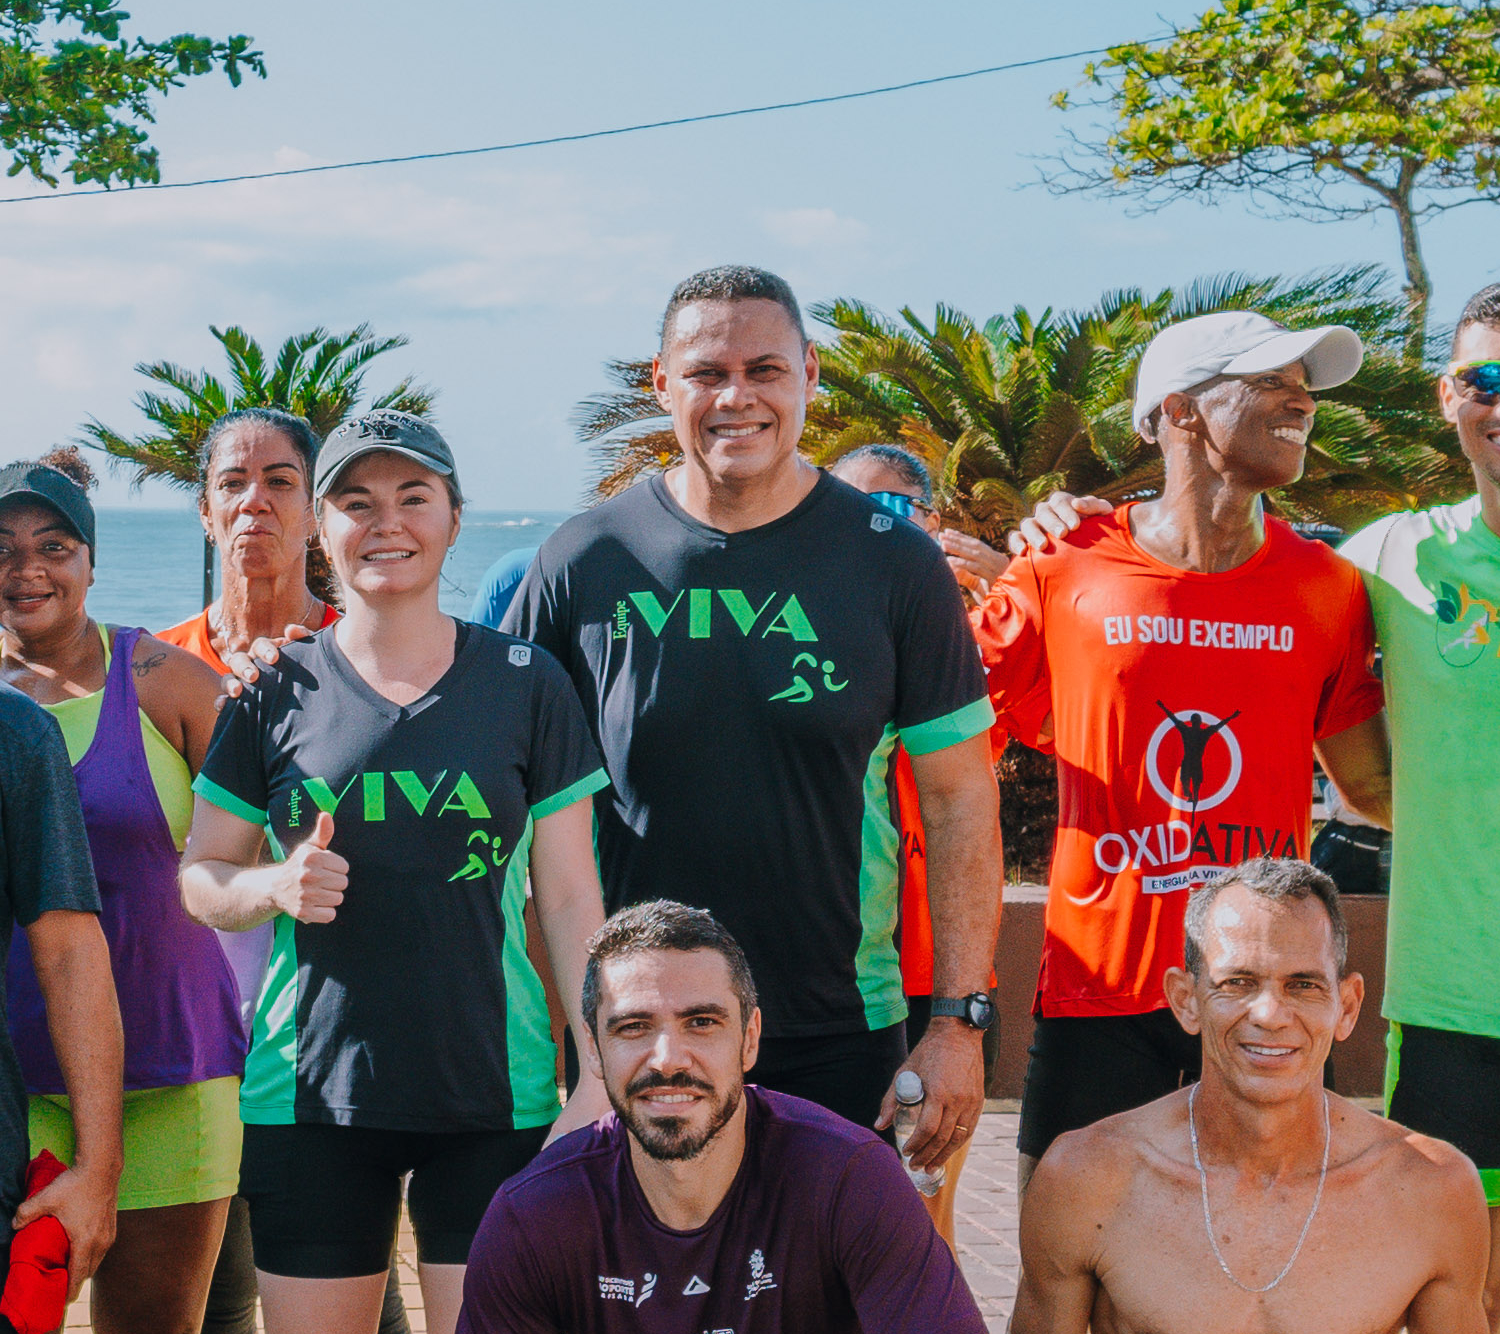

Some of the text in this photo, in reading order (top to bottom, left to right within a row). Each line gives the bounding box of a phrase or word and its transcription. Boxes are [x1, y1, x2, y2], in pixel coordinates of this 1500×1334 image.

[612, 588, 819, 642] Equipe VIVA
[1104, 615, 1294, 653] EU SOU EXEMPLO
[288, 769, 492, 828] Equipe VIVA
[1094, 820, 1299, 874] OXIDATIVA
